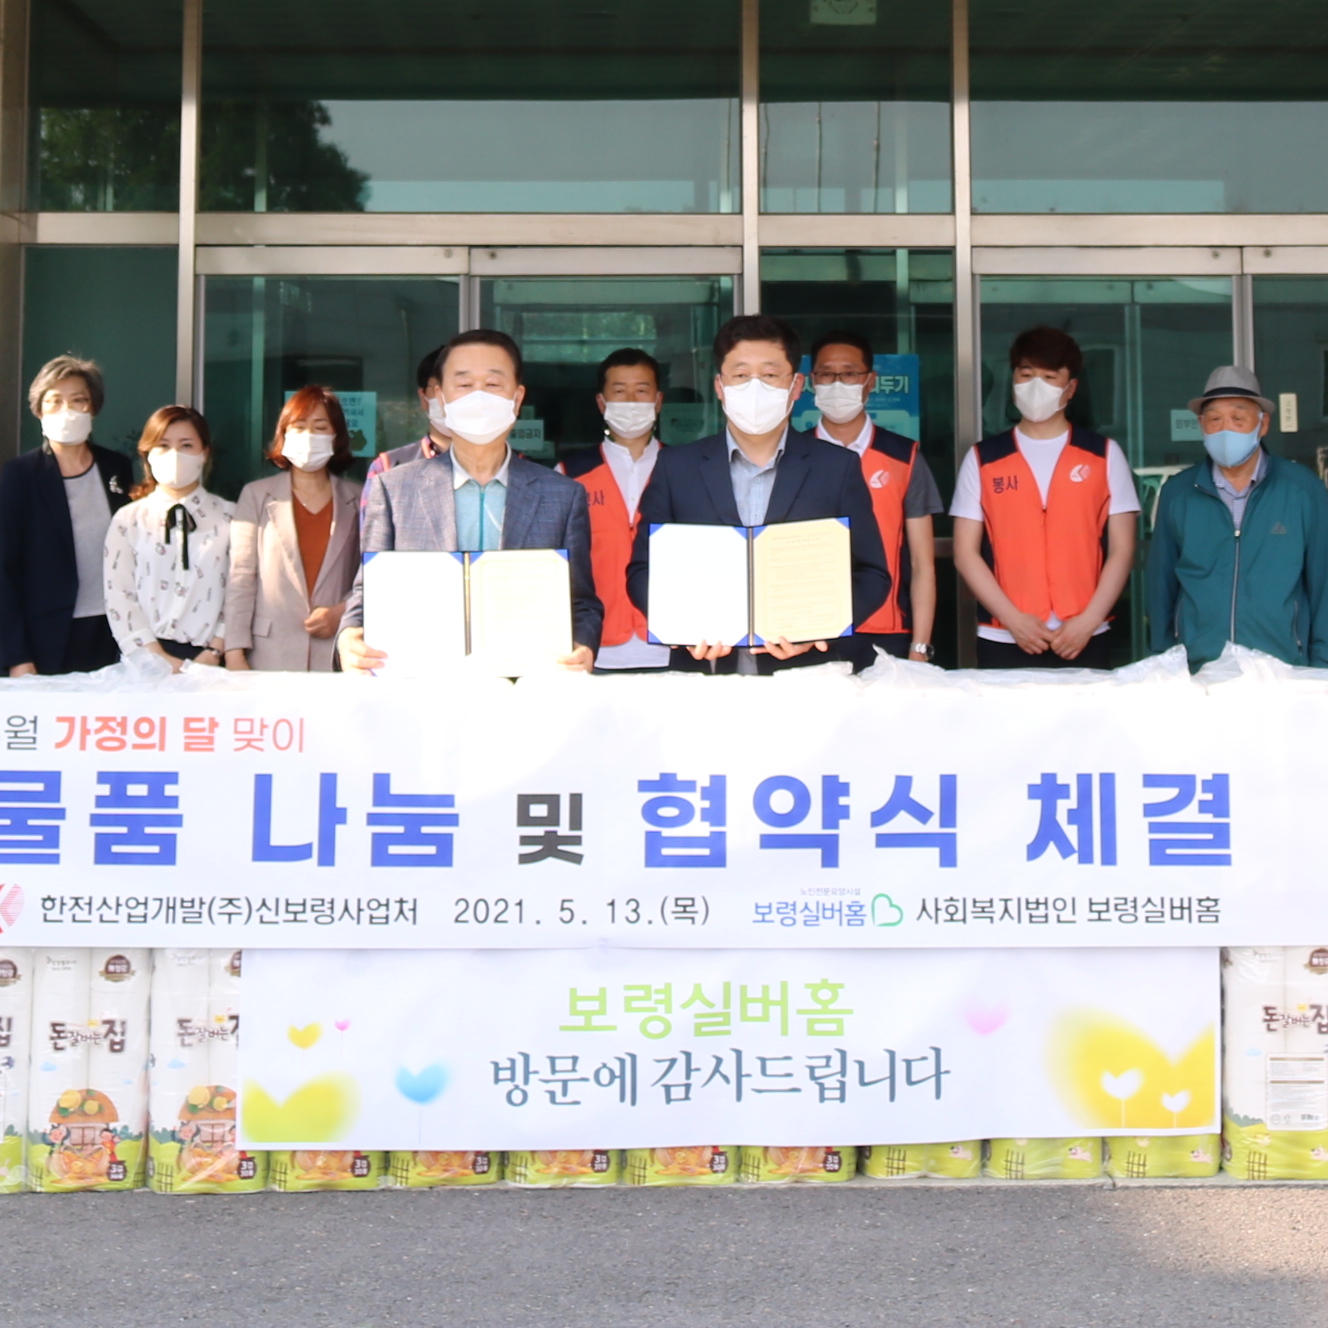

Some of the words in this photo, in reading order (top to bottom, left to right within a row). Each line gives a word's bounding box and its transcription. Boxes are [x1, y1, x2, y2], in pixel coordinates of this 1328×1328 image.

[993, 475, 1018, 494] 봉사
[54, 715, 167, 752] 가정의
[183, 716, 220, 753] 달
[232, 717, 305, 753] 맞이
[251, 772, 460, 869] 나눔
[515, 792, 585, 866] 및
[637, 772, 958, 869] 협약식
[1026, 772, 1233, 867] 체결
[800, 887, 861, 896] 노인전문요양시설
[40, 894, 418, 926] 한전산업개발(주)신보령사업처
[453, 897, 541, 926] 2021.
[559, 898, 588, 926] 5.
[606, 895, 710, 927] 13.(목)
[752, 900, 867, 927] 보령실버홈
[916, 896, 1077, 925] 사회복지법인
[1087, 895, 1221, 925] 보령실버홈
[558, 977, 854, 1040] 보령실버홈
[1263, 1006, 1278, 1032] 돈
[50, 1022, 66, 1051] 돈
[103, 1020, 127, 1053] 집
[177, 1018, 193, 1047] 돈
[490, 1051, 638, 1108] 방문에
[650, 1045, 951, 1106] 감사드립니다
